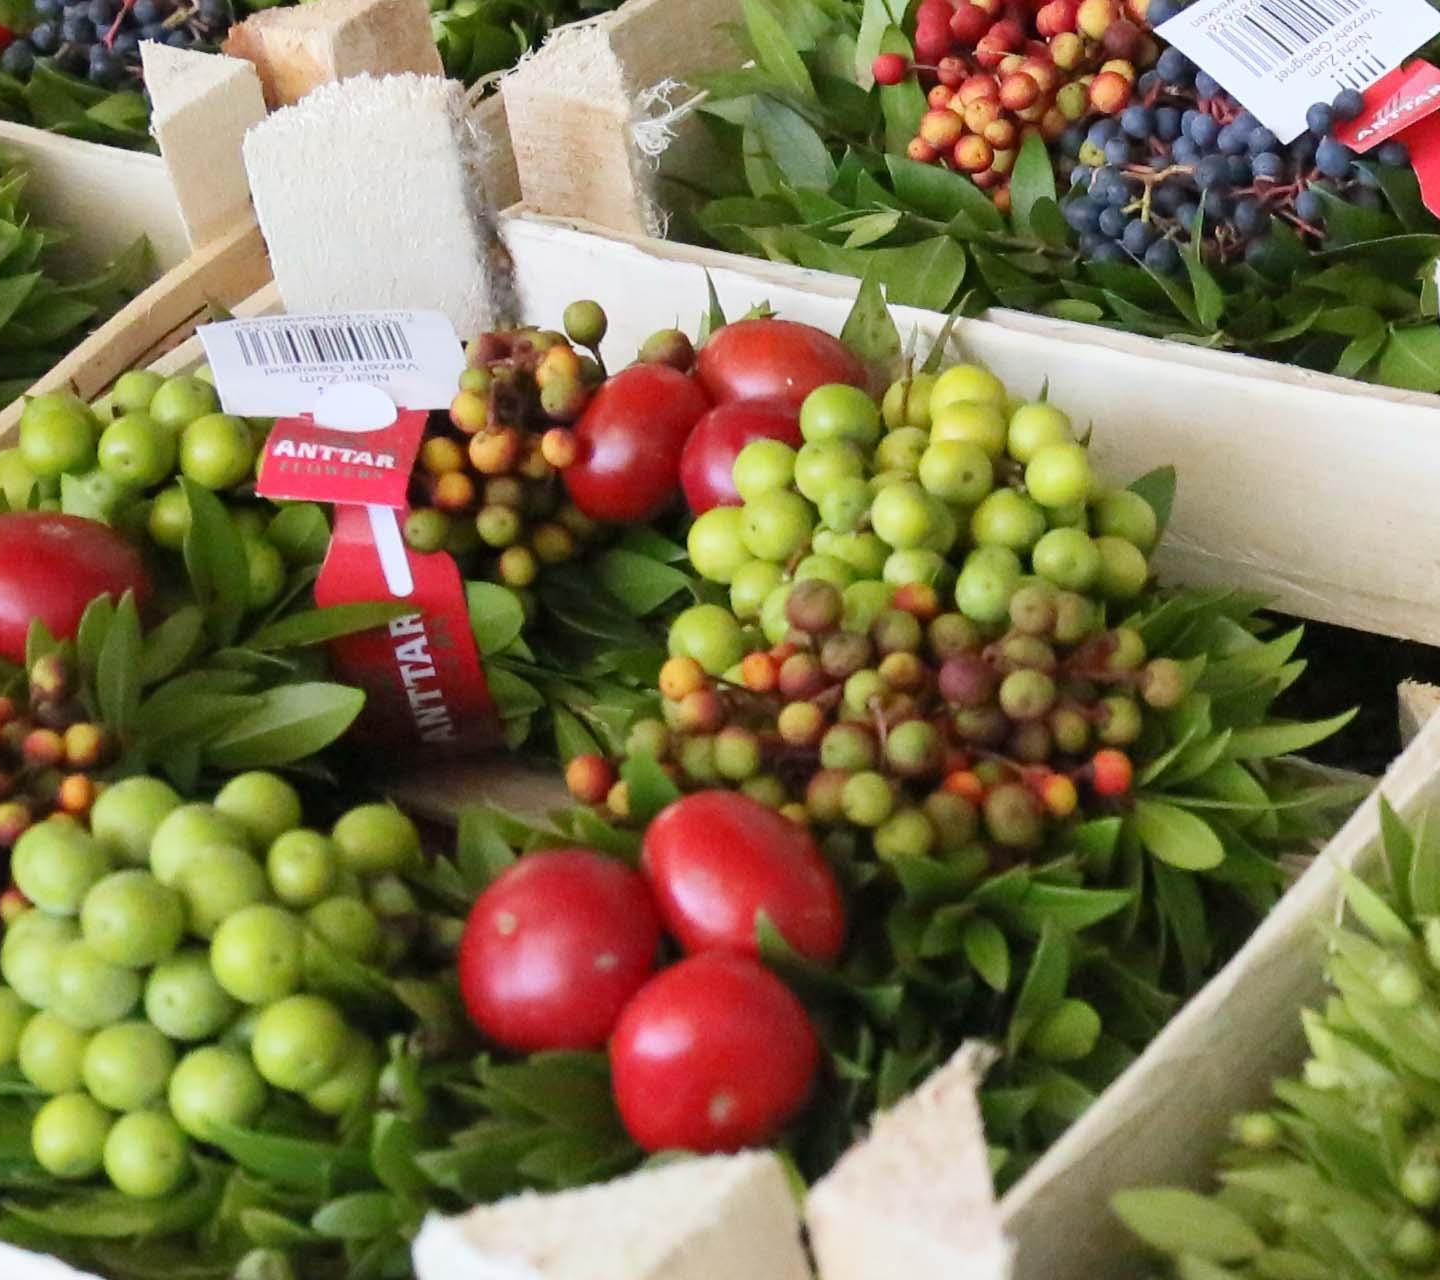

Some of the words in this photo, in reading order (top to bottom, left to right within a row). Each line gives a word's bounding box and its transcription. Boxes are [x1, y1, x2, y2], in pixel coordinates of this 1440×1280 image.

[1330, 7, 1381, 42] Verzehr
[1337, 31, 1373, 57] Nicht
[1271, 39, 1333, 82] Geeignet
[1306, 54, 1340, 78] Zum
[272, 439, 396, 469] ANTTAR
[389, 613, 457, 743] ANTTAR
